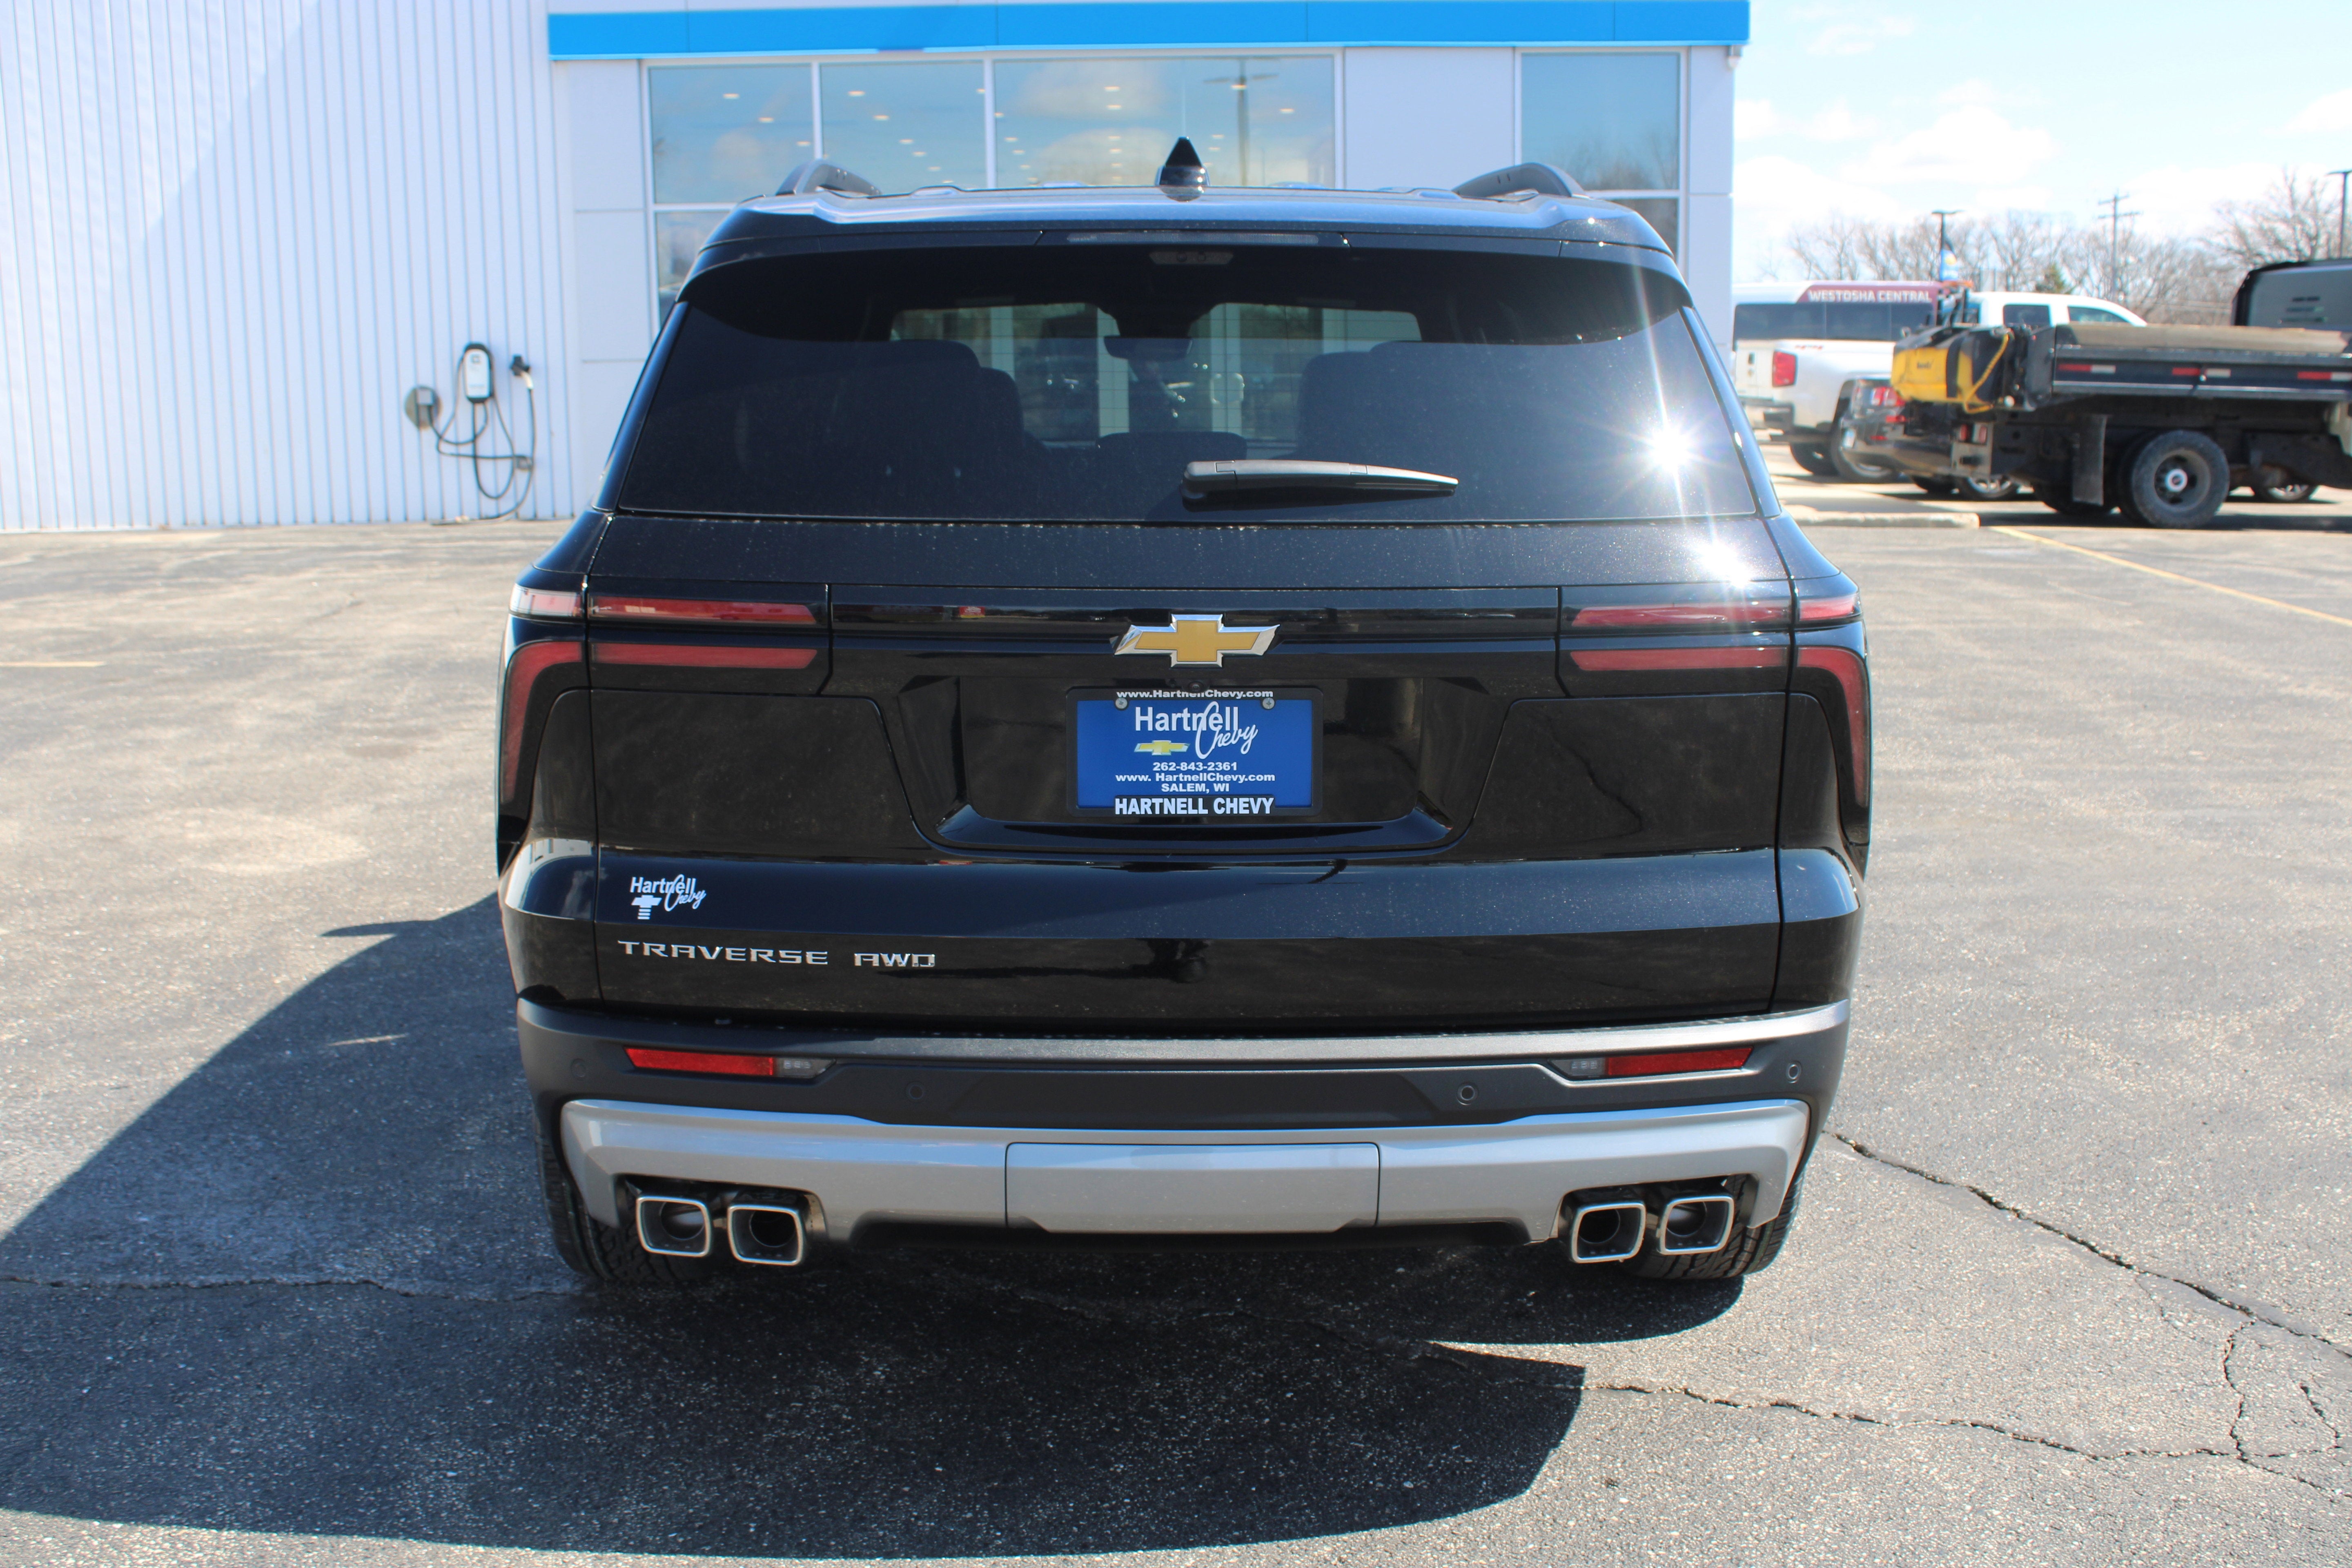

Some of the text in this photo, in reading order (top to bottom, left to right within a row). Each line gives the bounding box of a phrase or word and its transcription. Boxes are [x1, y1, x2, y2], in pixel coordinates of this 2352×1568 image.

[1808, 290, 1933, 303] WESTOSHA CENTRAL
[1116, 689, 1274, 699] www.HartnellChevy.com
[1135, 706, 1238, 731] Hartnell
[1195, 701, 1258, 760] Chevy
[1152, 762, 1238, 771] 262-843-2361
[1156, 773, 1276, 783] HartnellChevy.com
[1161, 783, 1230, 793] SALEM, WI
[1115, 797, 1274, 815] HARTNELL CHEVY
[630, 877, 696, 893] Hartnell
[664, 874, 707, 912] Chevy
[617, 940, 935, 967] TRAVERSE AWD
